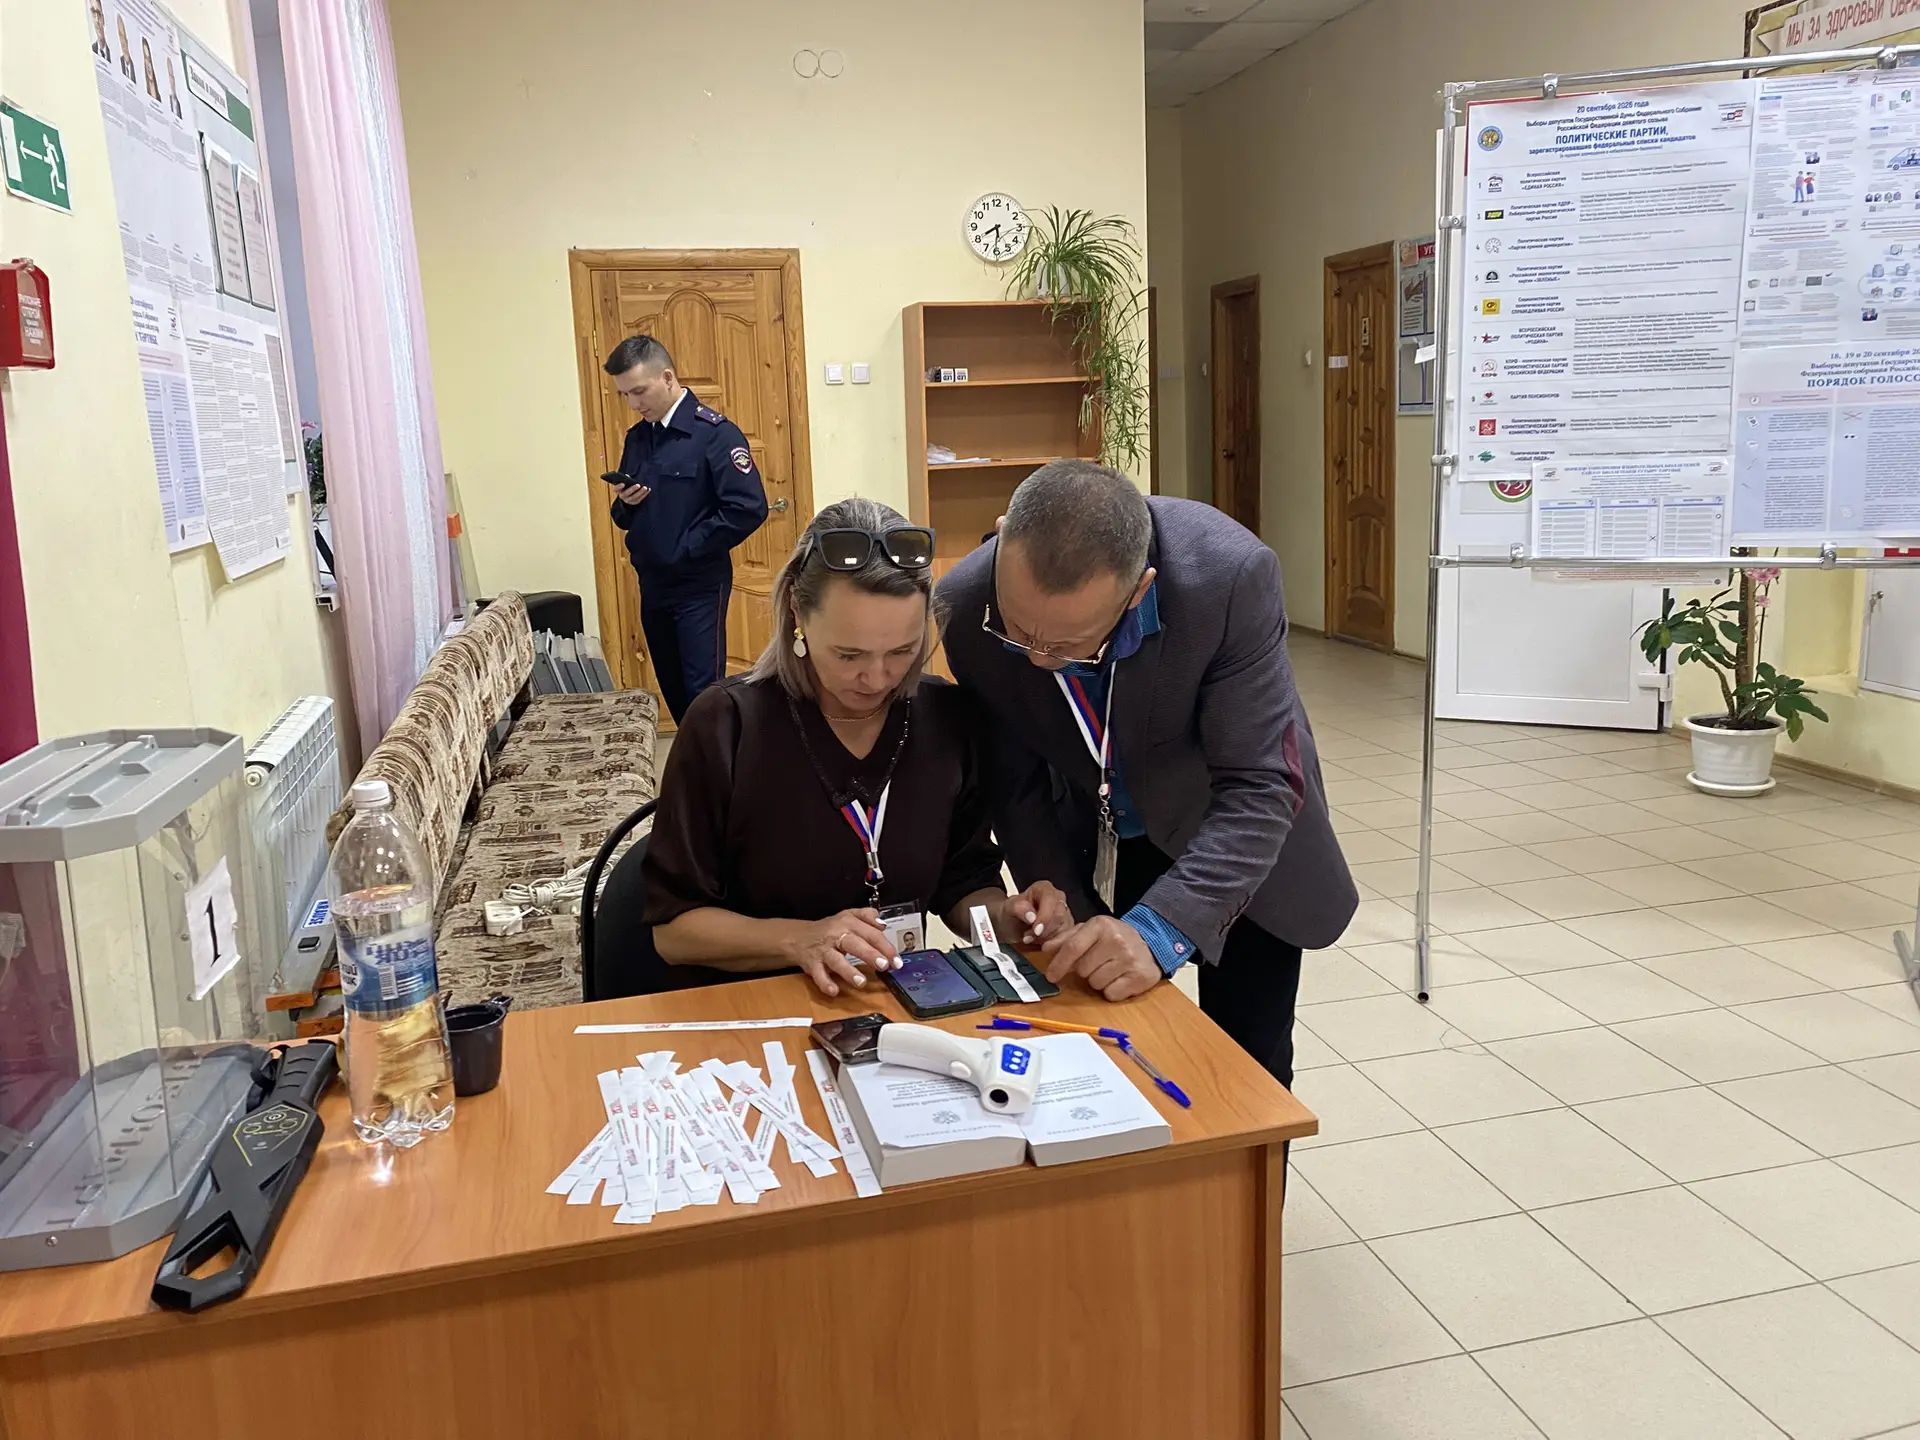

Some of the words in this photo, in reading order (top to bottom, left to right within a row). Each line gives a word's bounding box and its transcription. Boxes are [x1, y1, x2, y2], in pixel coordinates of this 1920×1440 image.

[1786, 19, 1805, 47] МЫ
[1808, 14, 1820, 41] ЗА
[1826, 0, 1884, 40] ЗДОРОВЫЙ
[1586, 104, 1616, 112] сентября
[1617, 101, 1633, 110] 2026
[1634, 100, 1650, 108] года
[1548, 117, 1574, 126] депутатов
[1575, 113, 1620, 124] Государственной
[1620, 111, 1635, 120] Думы
[1636, 108, 1675, 118] Федерального
[1676, 106, 1703, 114] Собрания
[1556, 123, 1589, 132] Российской
[1590, 120, 1621, 130] Федерации
[1556, 130, 1628, 145] ПОЛИТИЧЕСКИЕ
[1630, 126, 1669, 138] ПАРТИИ,
[1529, 143, 1592, 156] зарегистрировавшие
[1593, 139, 1636, 150] федеральные
[1636, 137, 1659, 146] списки
[1660, 134, 1697, 144] кандидатов
[982, 202, 990, 210] 11
[992, 198, 1002, 207] 12
[974, 211, 984, 219] 10
[1012, 212, 1019, 220] 2
[970, 222, 978, 231] 9
[1016, 223, 1022, 232] 3
[974, 235, 981, 243] 8
[1012, 236, 1018, 244] 4
[983, 244, 989, 252] 7
[993, 247, 1000, 256] 6
[1005, 244, 1011, 252] 5
[1874, 349, 1910, 357] сентября
[1800, 369, 1852, 377] Федерального
[1807, 376, 1868, 388] ПОРЯДОК
[308, 901, 328, 926] KRAUSE
[204, 896, 221, 967] 1
